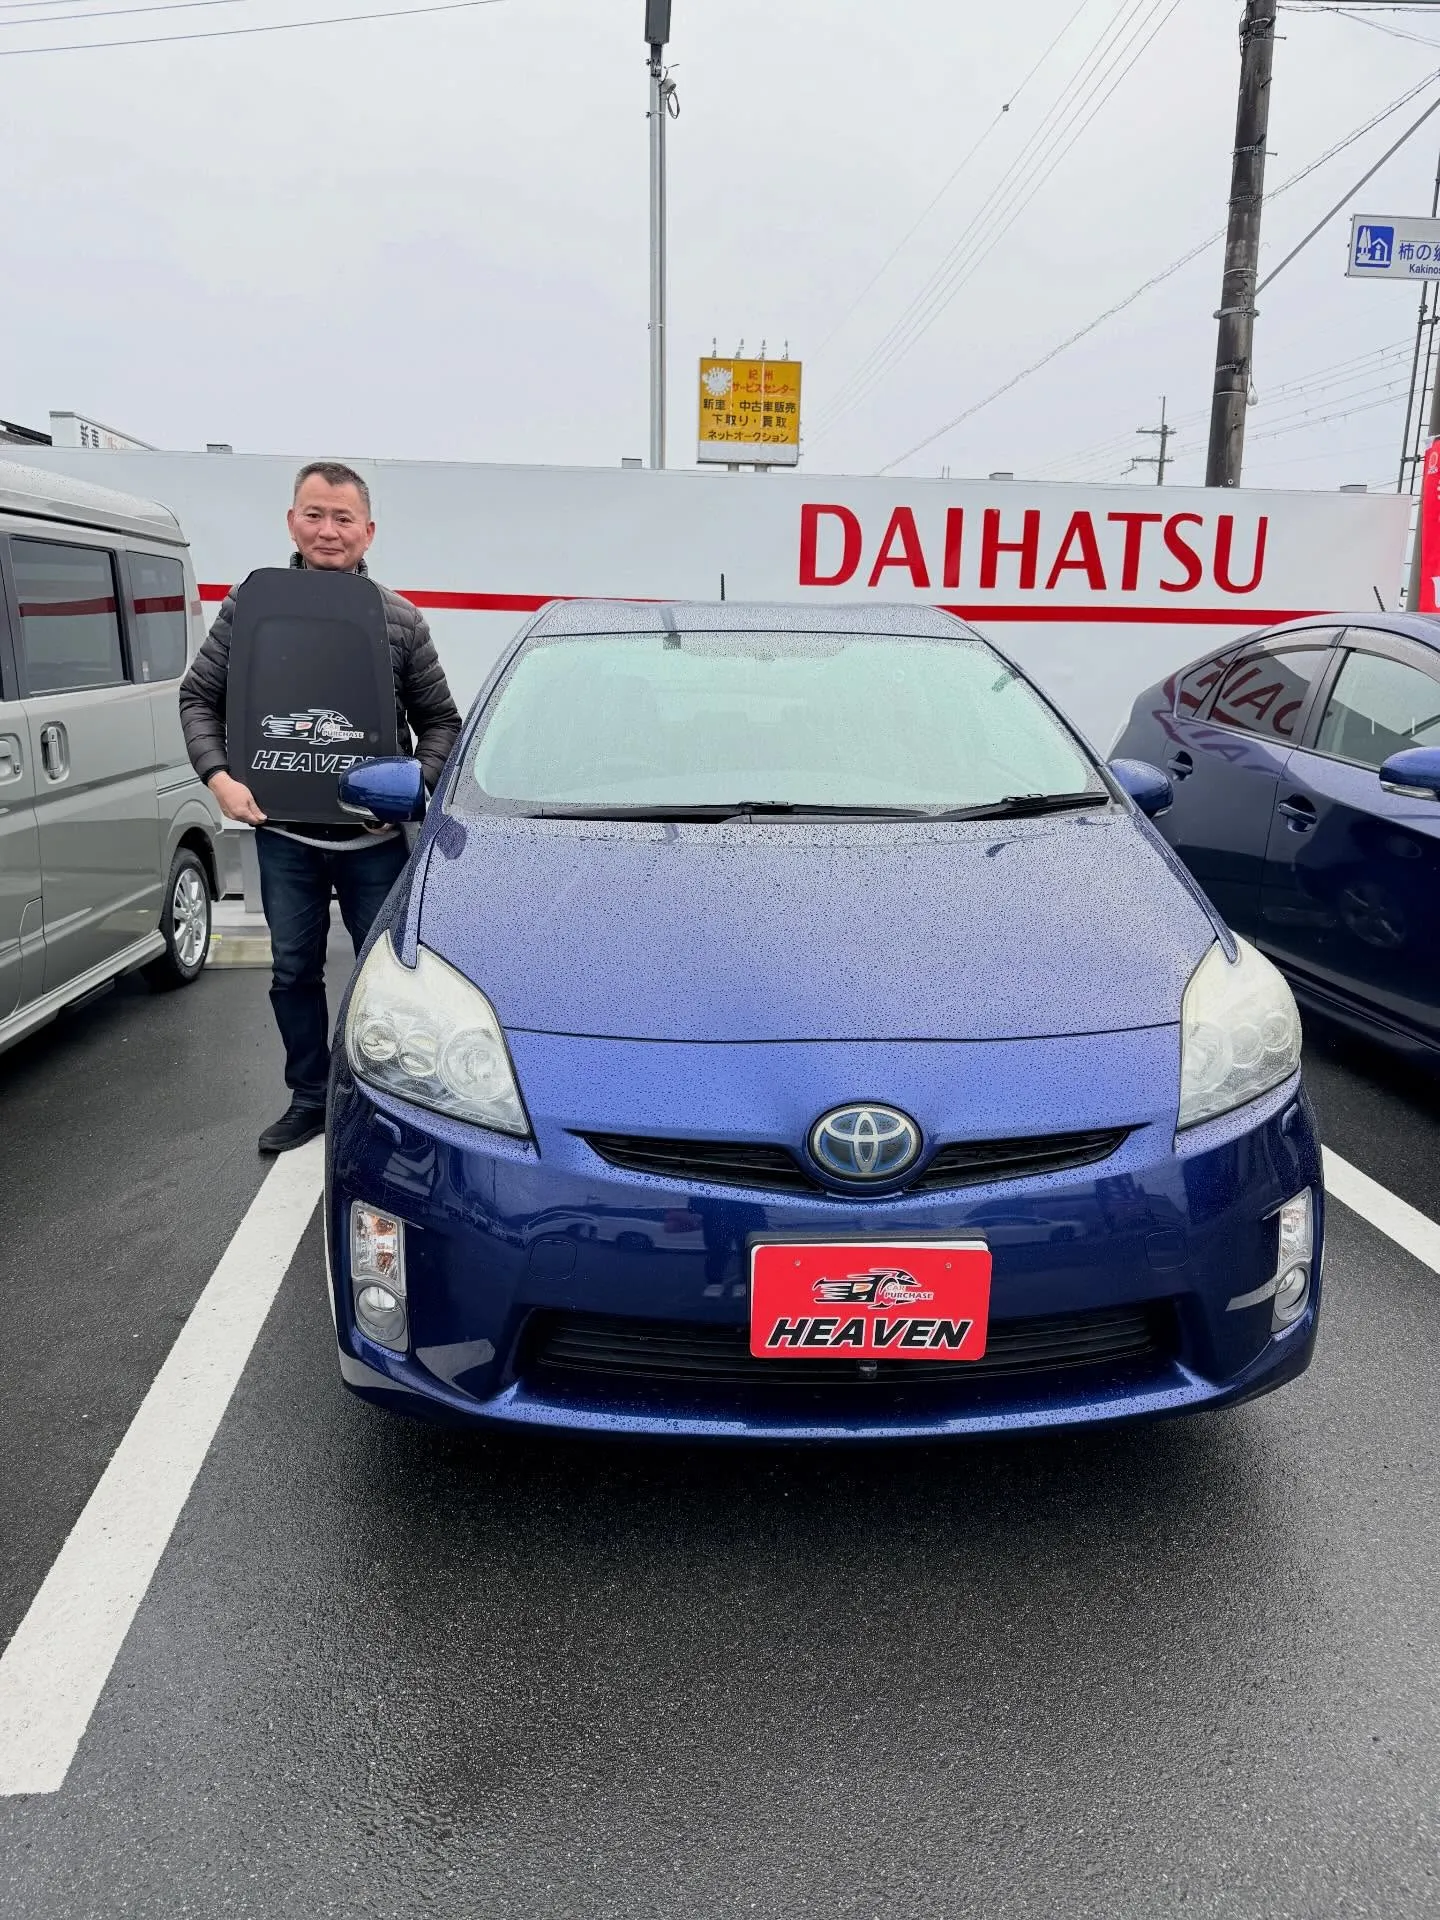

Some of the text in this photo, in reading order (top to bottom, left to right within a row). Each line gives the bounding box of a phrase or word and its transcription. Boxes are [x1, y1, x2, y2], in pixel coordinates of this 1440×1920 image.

[1409, 263, 1440, 275] Kakino
[748, 368, 774, 382] 紀州
[732, 382, 797, 395] サービスセンター
[703, 398, 797, 413] 新車・中古車販売
[711, 414, 788, 428] 下取り・買取
[707, 430, 790, 443] ネットオークション
[799, 502, 1269, 595] DAIHATSU
[321, 730, 365, 739] PURCHASE
[886, 1282, 907, 1292] CAR
[884, 1290, 934, 1301] PURCHASE
[765, 1316, 973, 1350] HEAVEN
